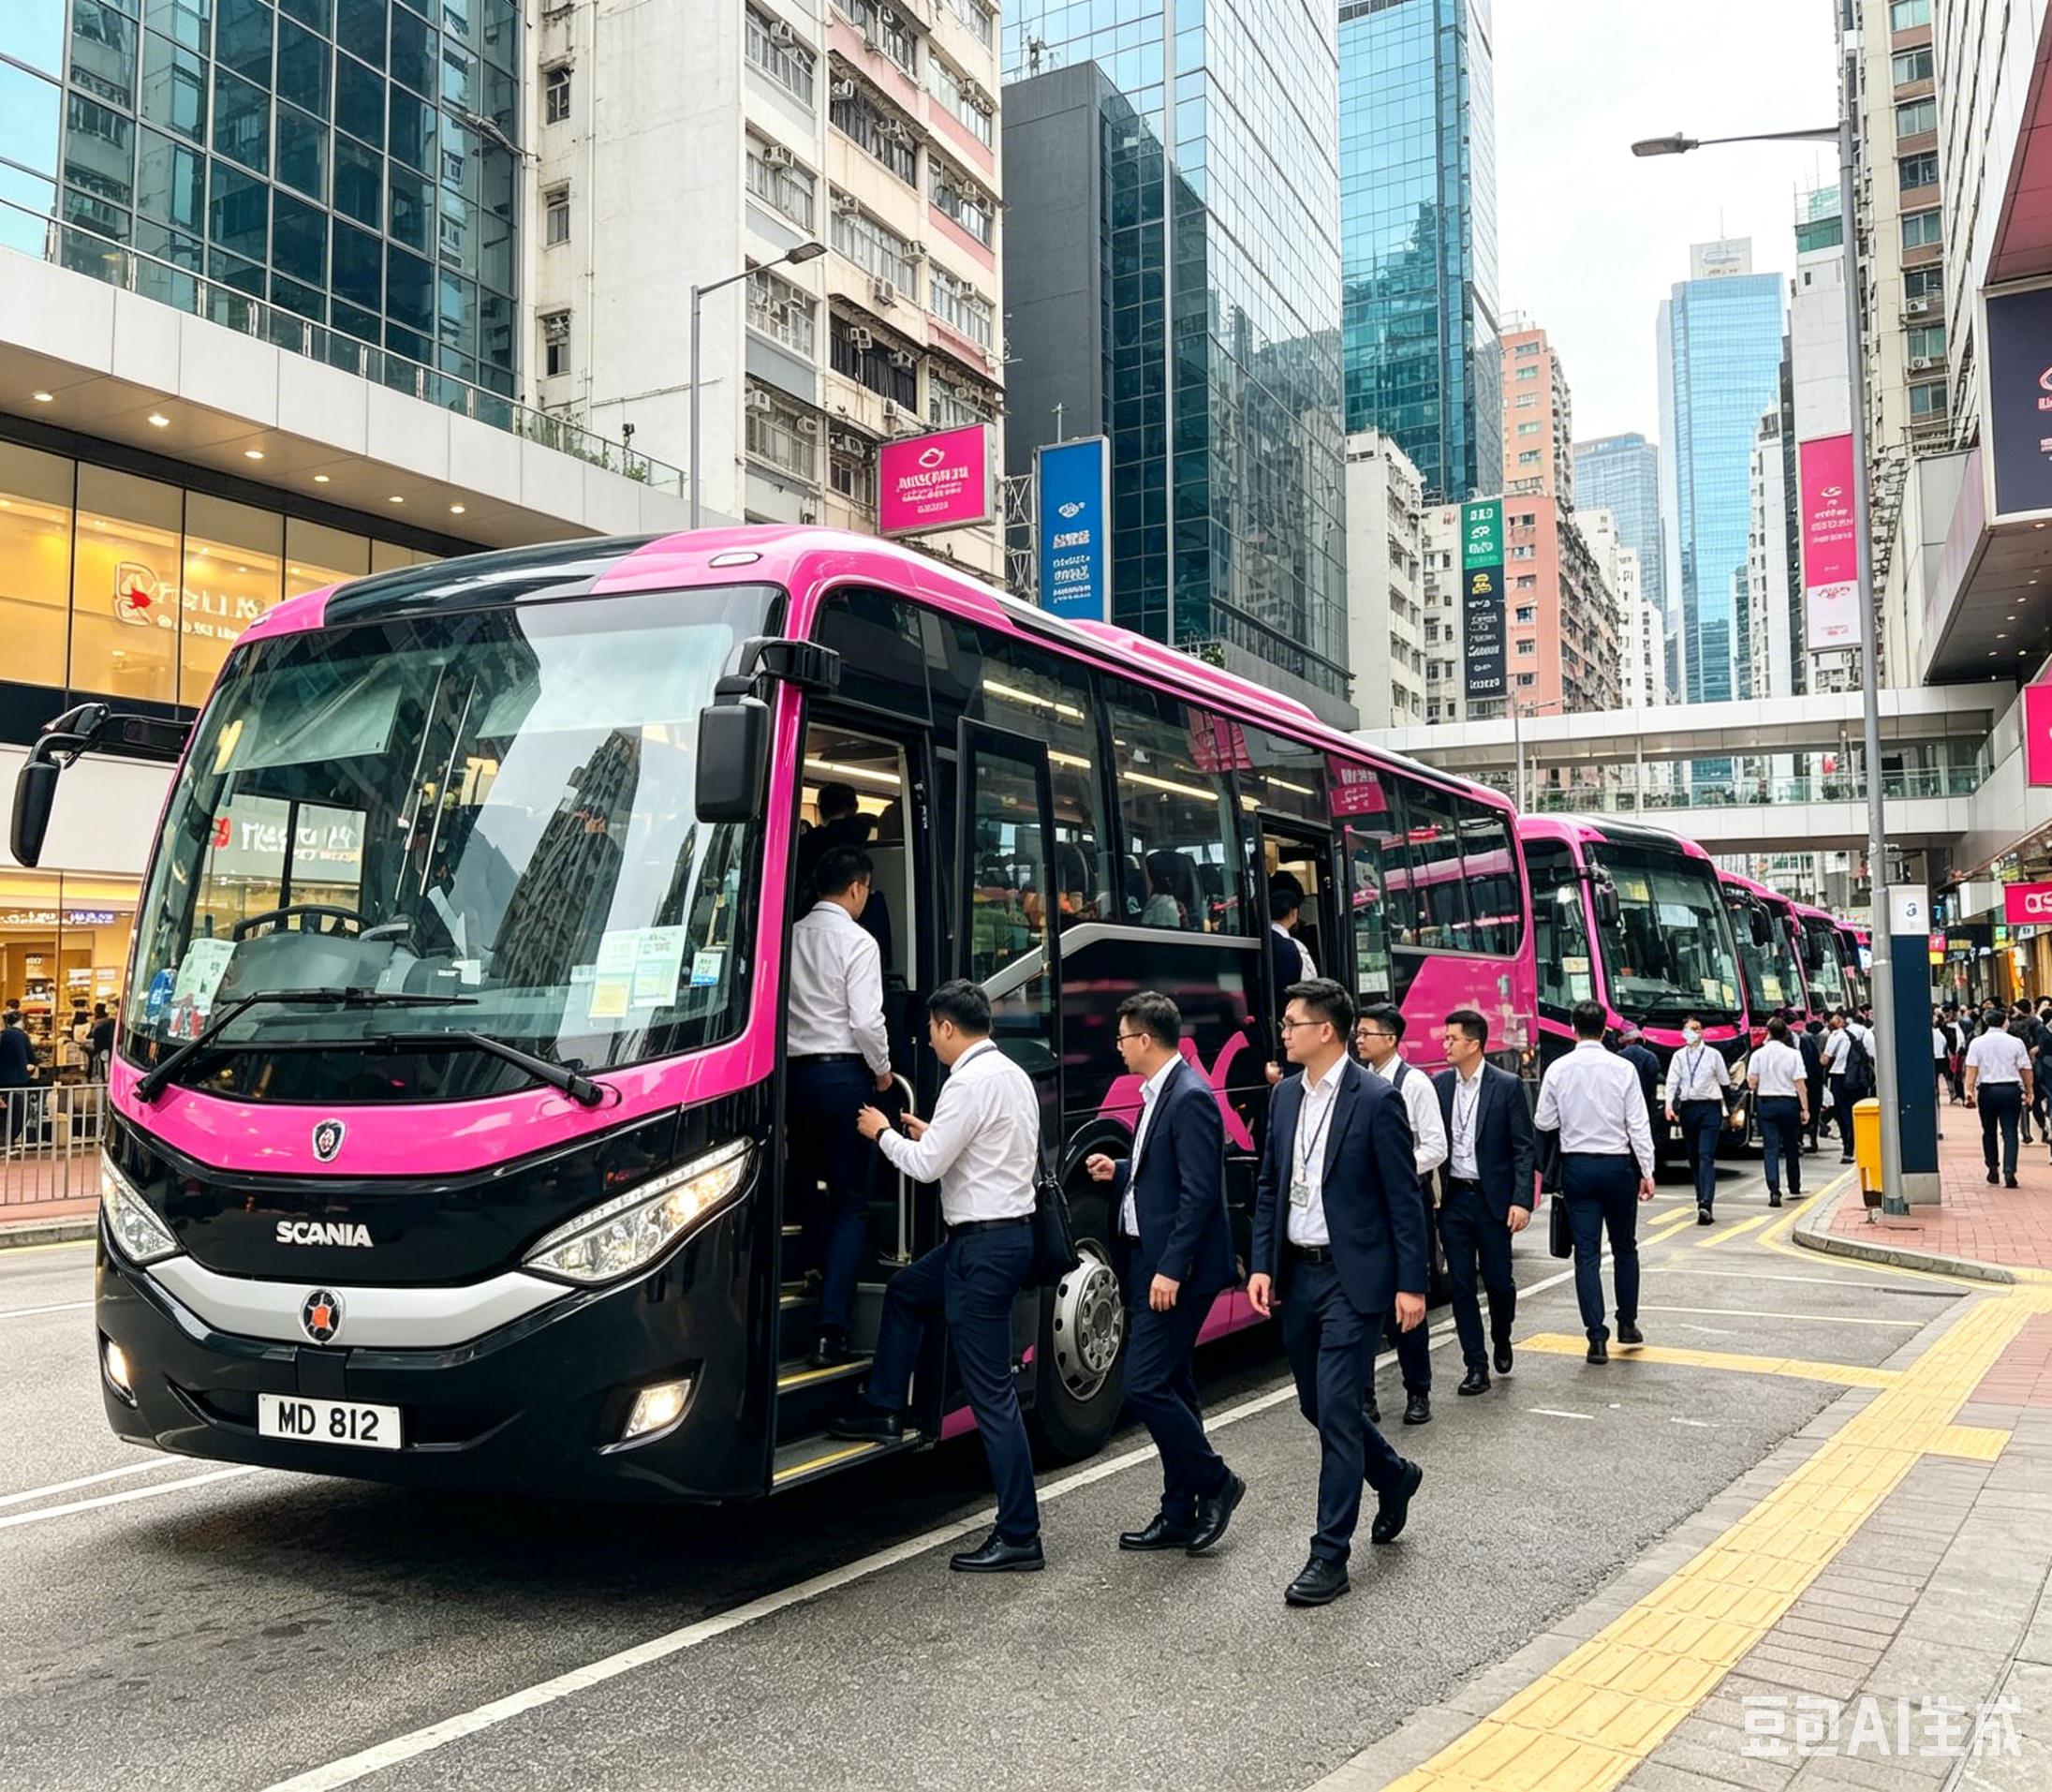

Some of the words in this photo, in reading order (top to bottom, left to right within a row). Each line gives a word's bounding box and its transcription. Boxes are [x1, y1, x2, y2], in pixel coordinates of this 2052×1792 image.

[276, 1221, 374, 1248] SCANIA
[278, 1401, 317, 1436] MD
[329, 1407, 379, 1443] 812
